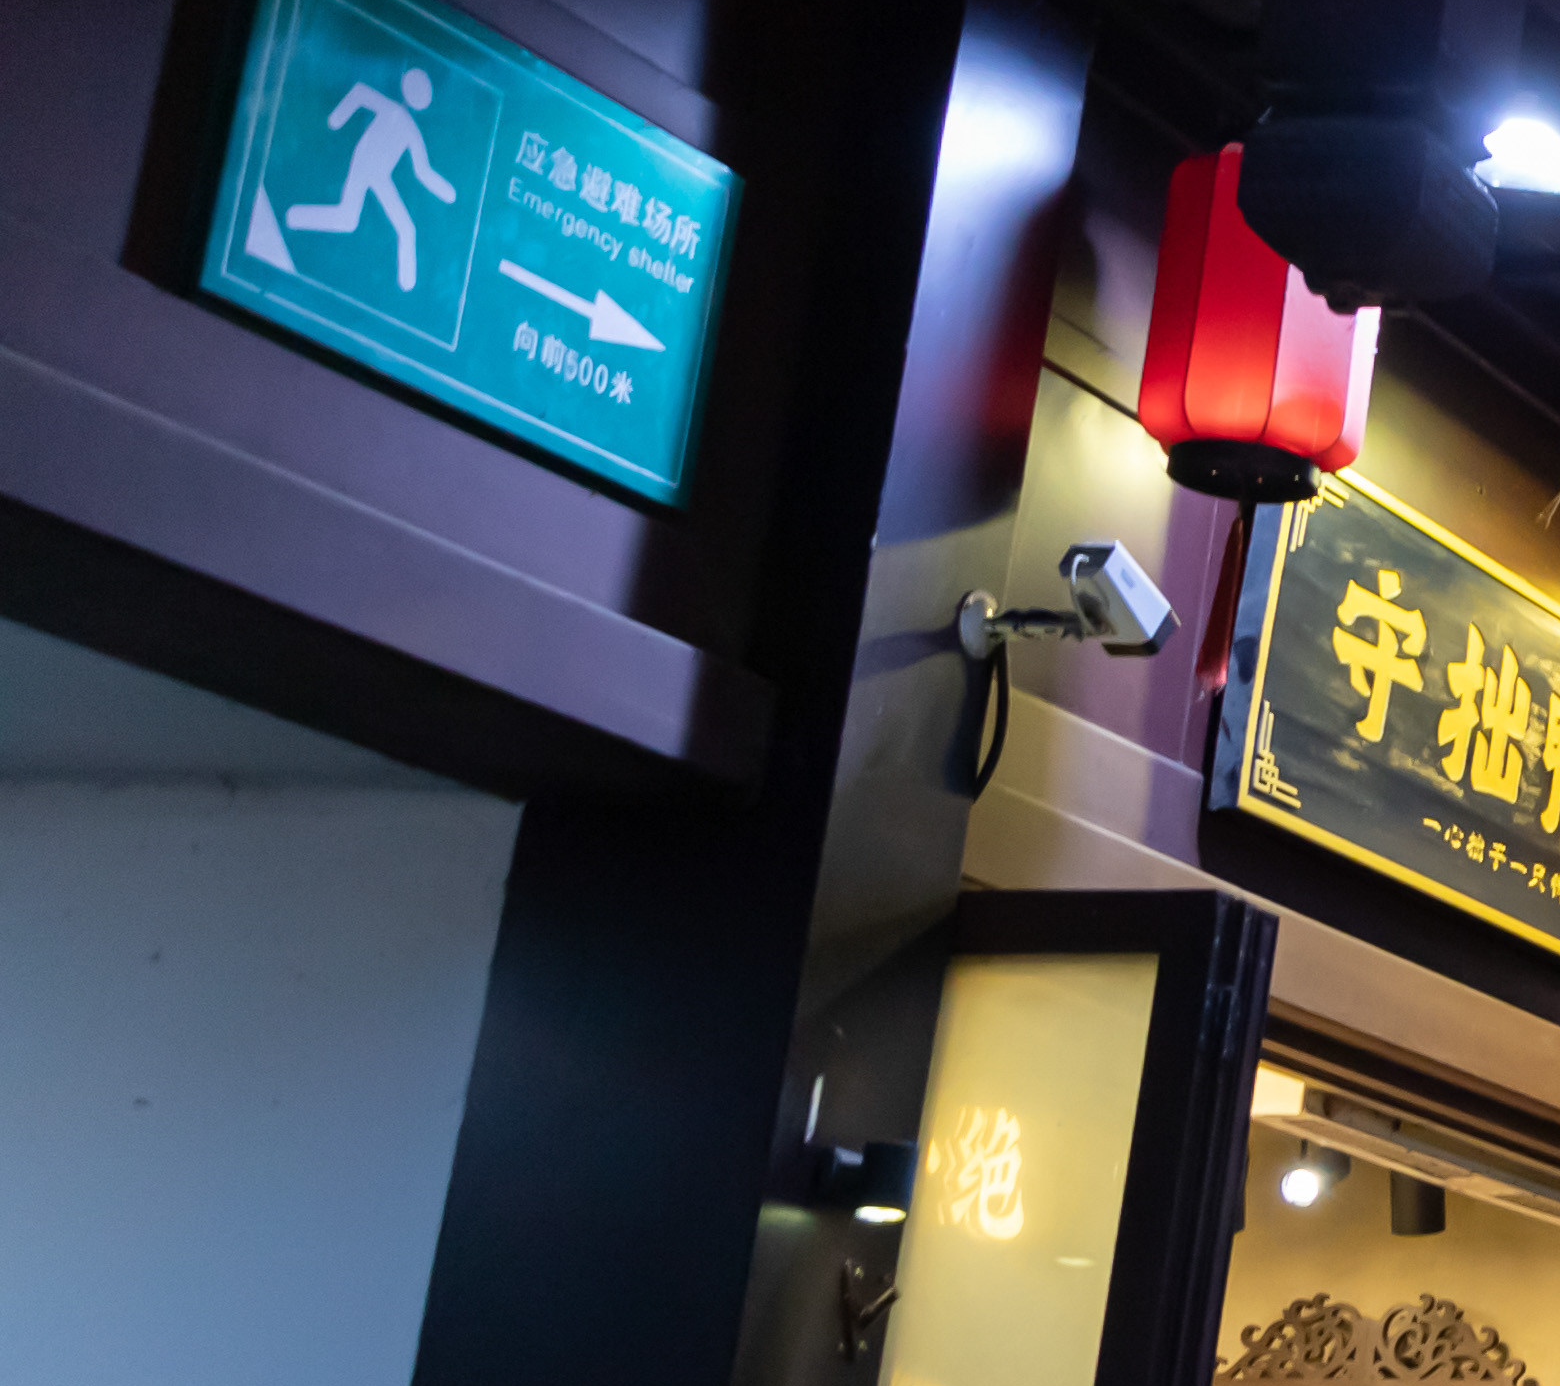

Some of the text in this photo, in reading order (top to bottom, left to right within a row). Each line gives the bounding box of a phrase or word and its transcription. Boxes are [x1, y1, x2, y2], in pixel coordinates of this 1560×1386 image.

[508, 177, 694, 293] Emergency shelter
[515, 131, 700, 259] 应急避难场所
[513, 321, 633, 404] 向前500米
